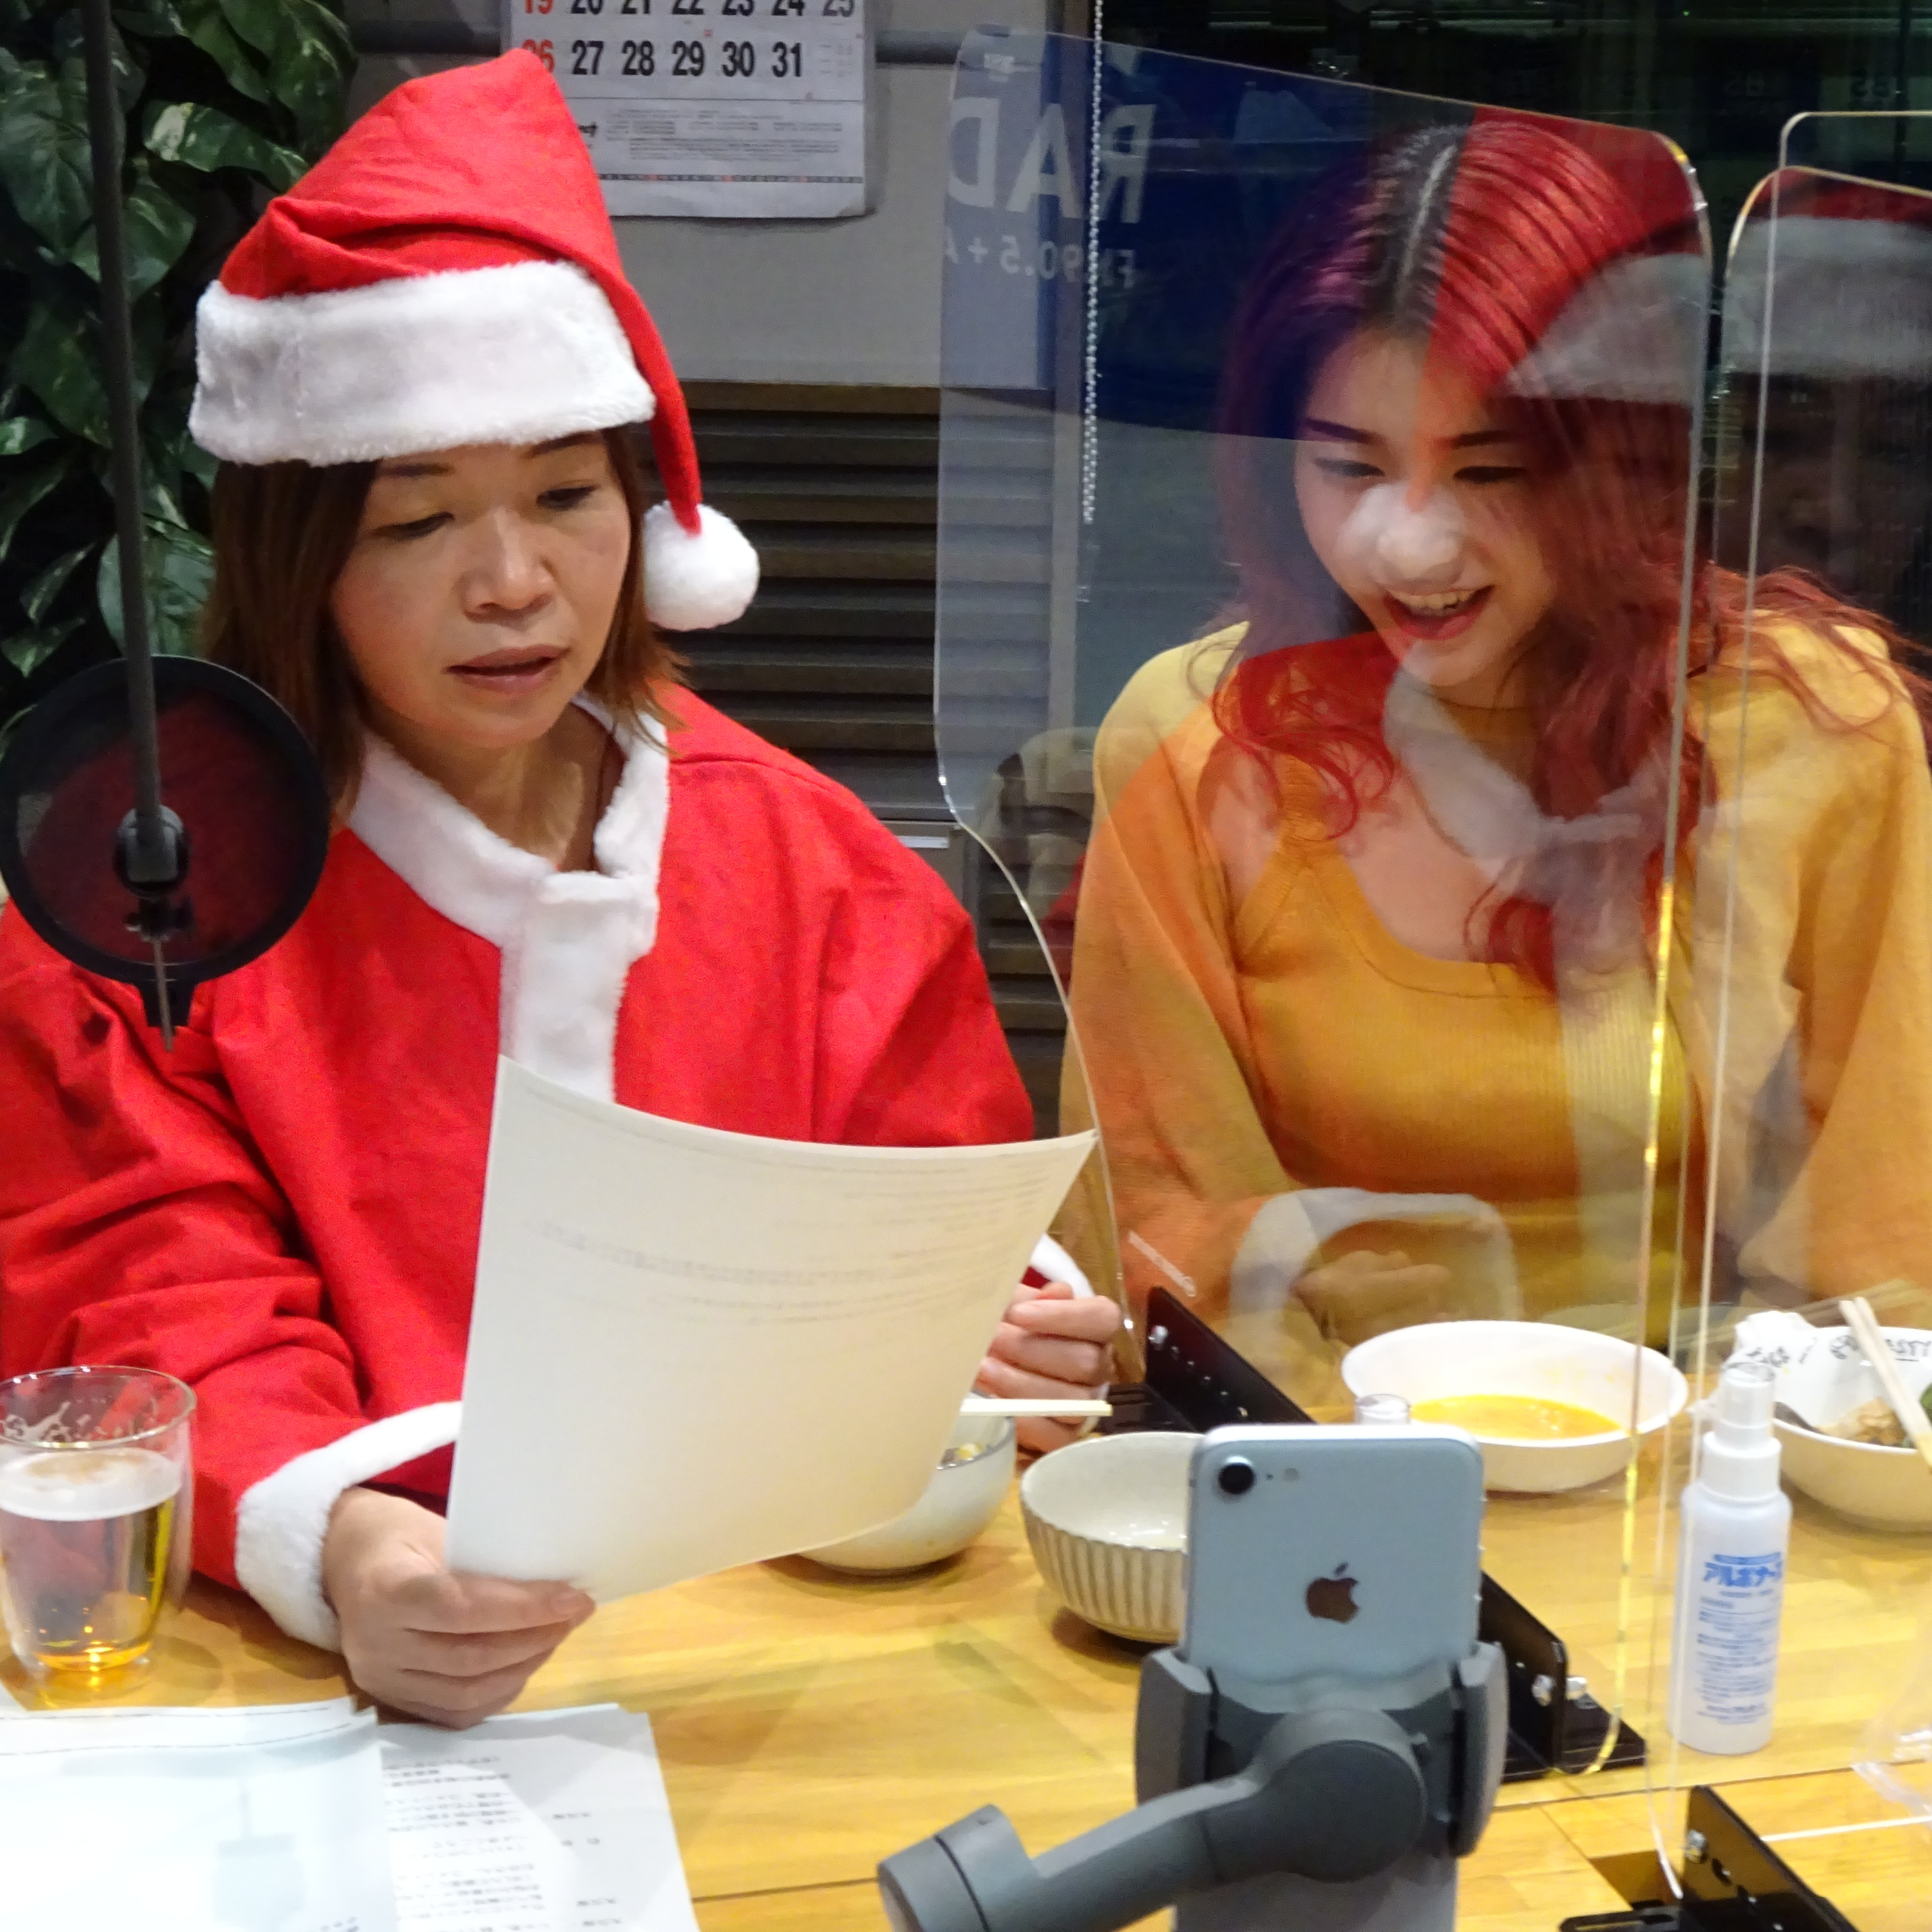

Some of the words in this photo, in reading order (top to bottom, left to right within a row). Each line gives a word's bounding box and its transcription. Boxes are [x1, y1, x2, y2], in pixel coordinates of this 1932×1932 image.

[571, 40, 604, 75] 27
[621, 41, 655, 76] 28
[672, 41, 705, 77] 29
[722, 41, 755, 77] 30
[772, 42, 802, 77] 31
